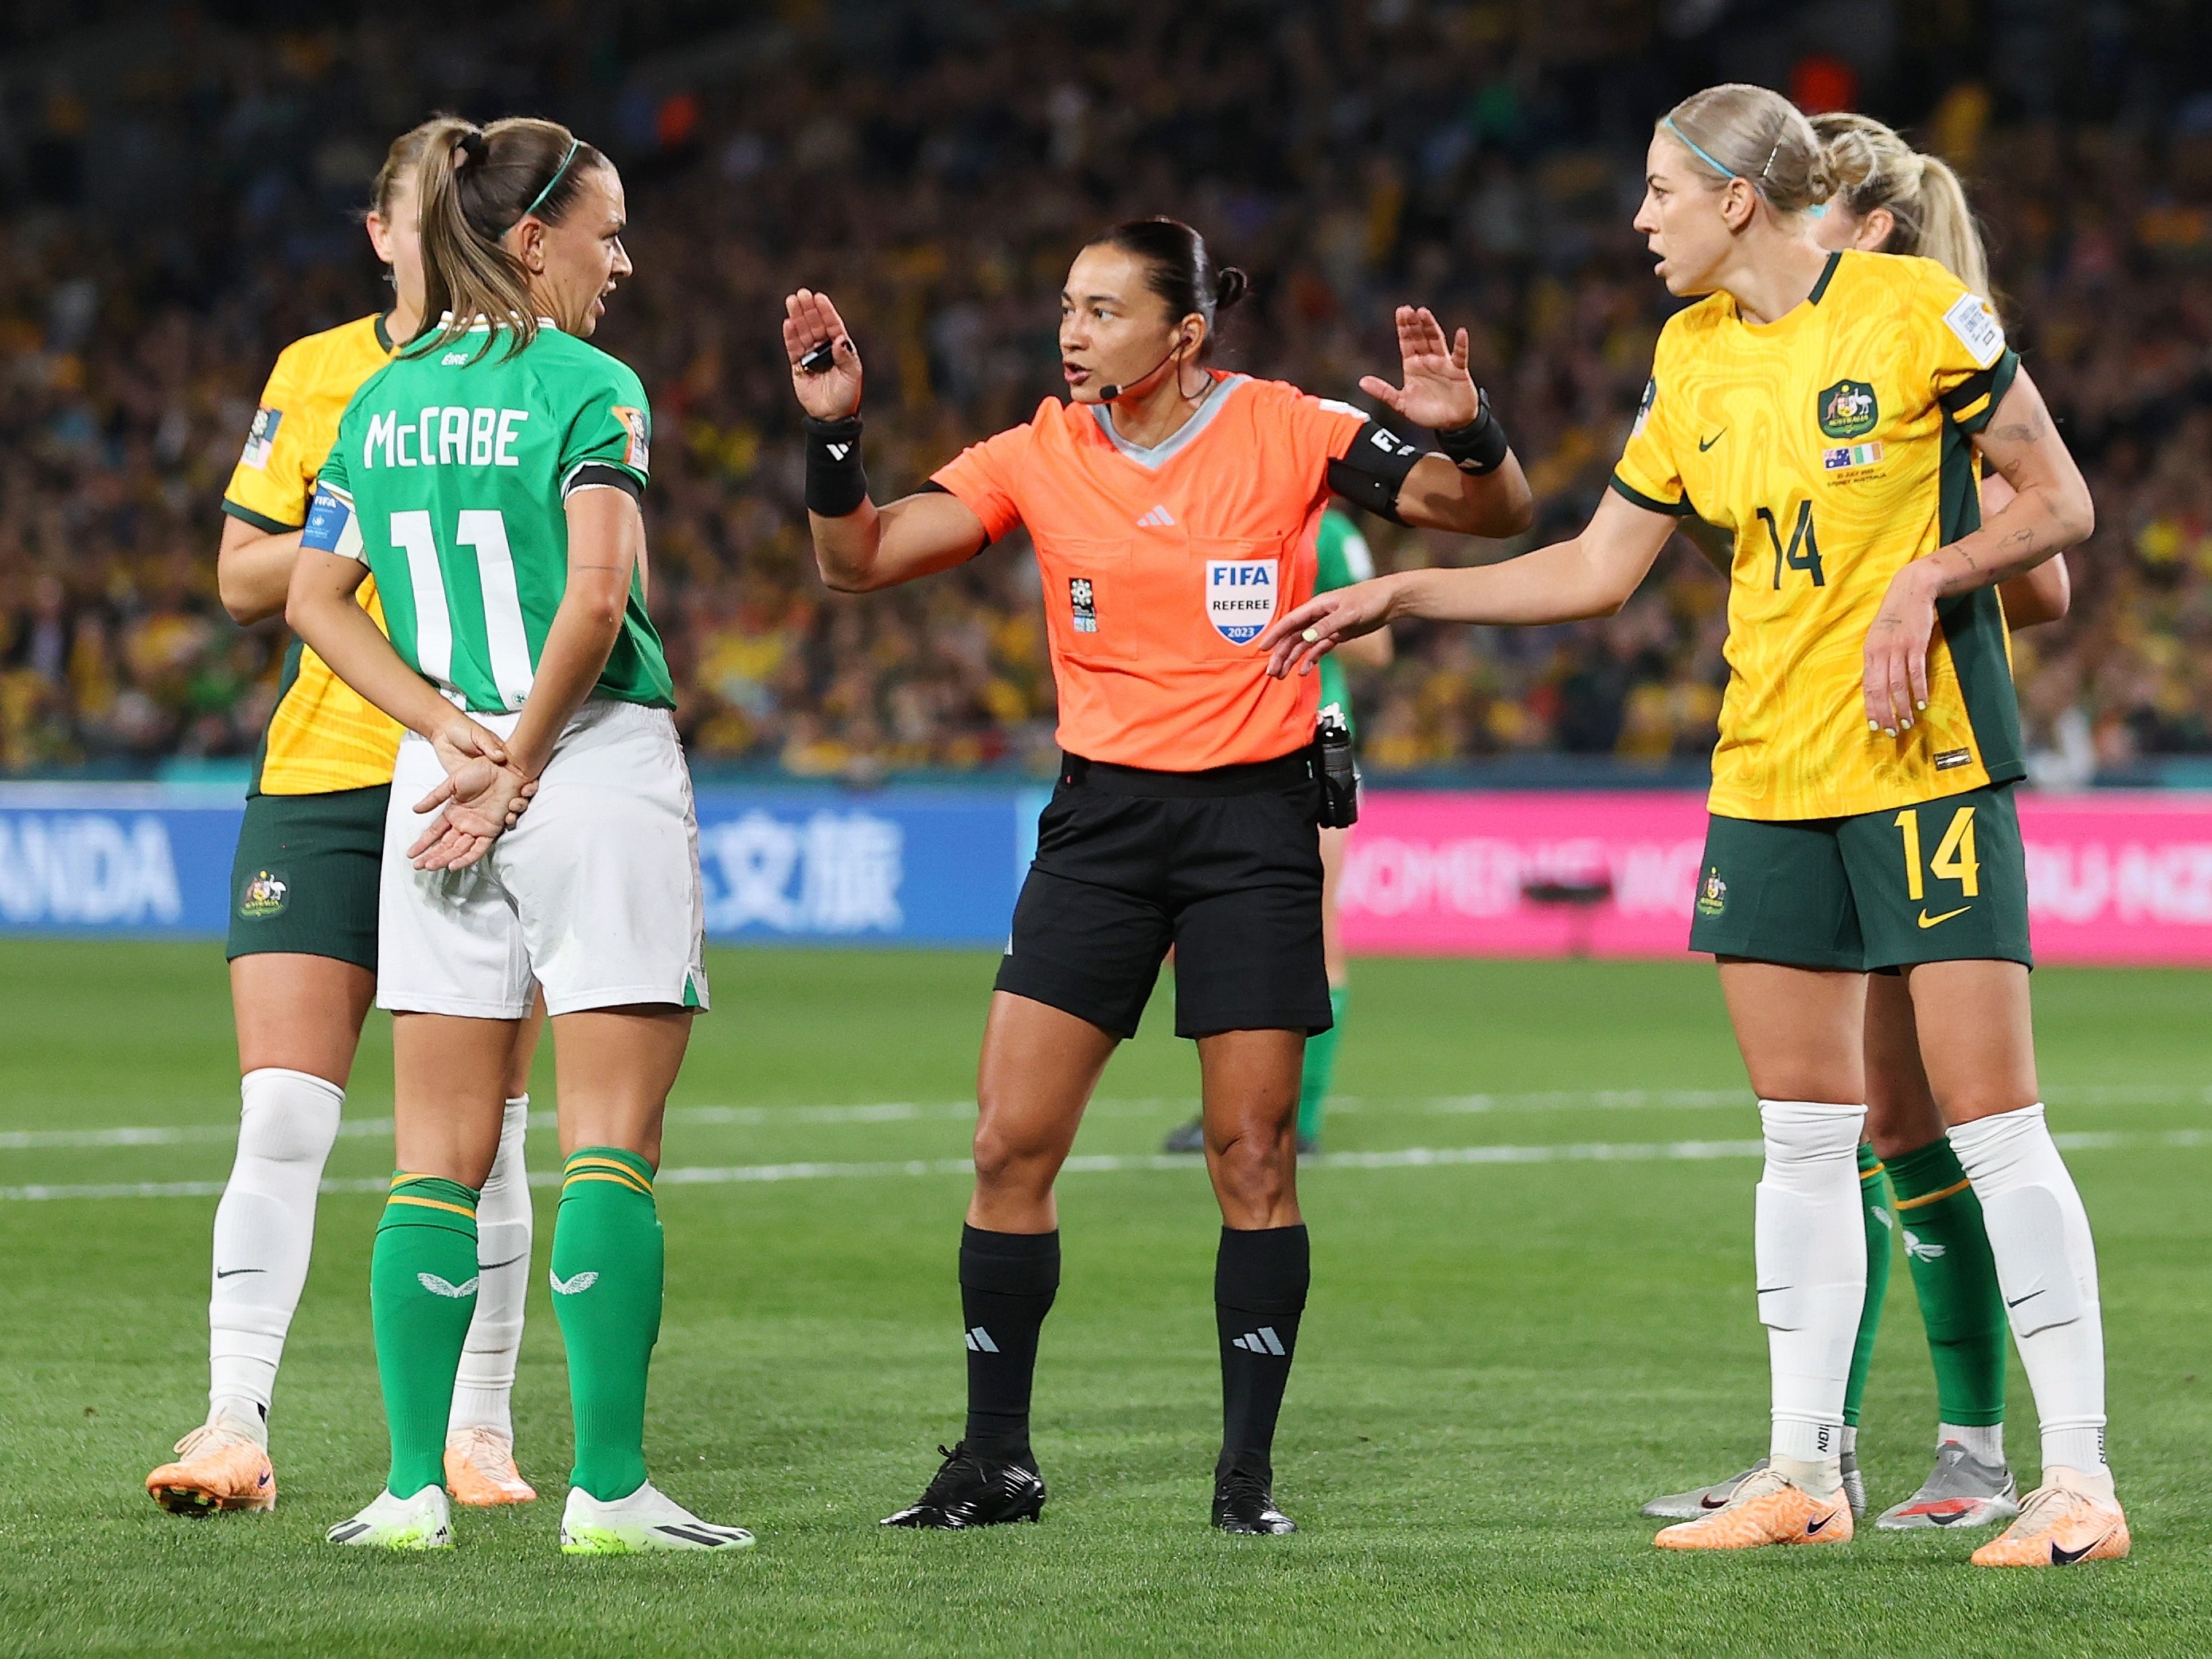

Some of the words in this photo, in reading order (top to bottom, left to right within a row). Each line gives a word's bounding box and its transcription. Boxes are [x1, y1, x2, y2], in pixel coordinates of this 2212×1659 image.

[441, 351, 468, 365] ÉIRE
[363, 406, 530, 468] McCABE
[314, 495, 337, 509] FIFA
[1757, 500, 1825, 591] 14
[1213, 567, 1269, 586] FIFA
[390, 509, 534, 712] 11
[1213, 599, 1270, 611] REFEREE
[1228, 627, 1255, 638] 2023
[1894, 806, 1980, 901] 14
[1818, 1425, 1829, 1452] IGN
